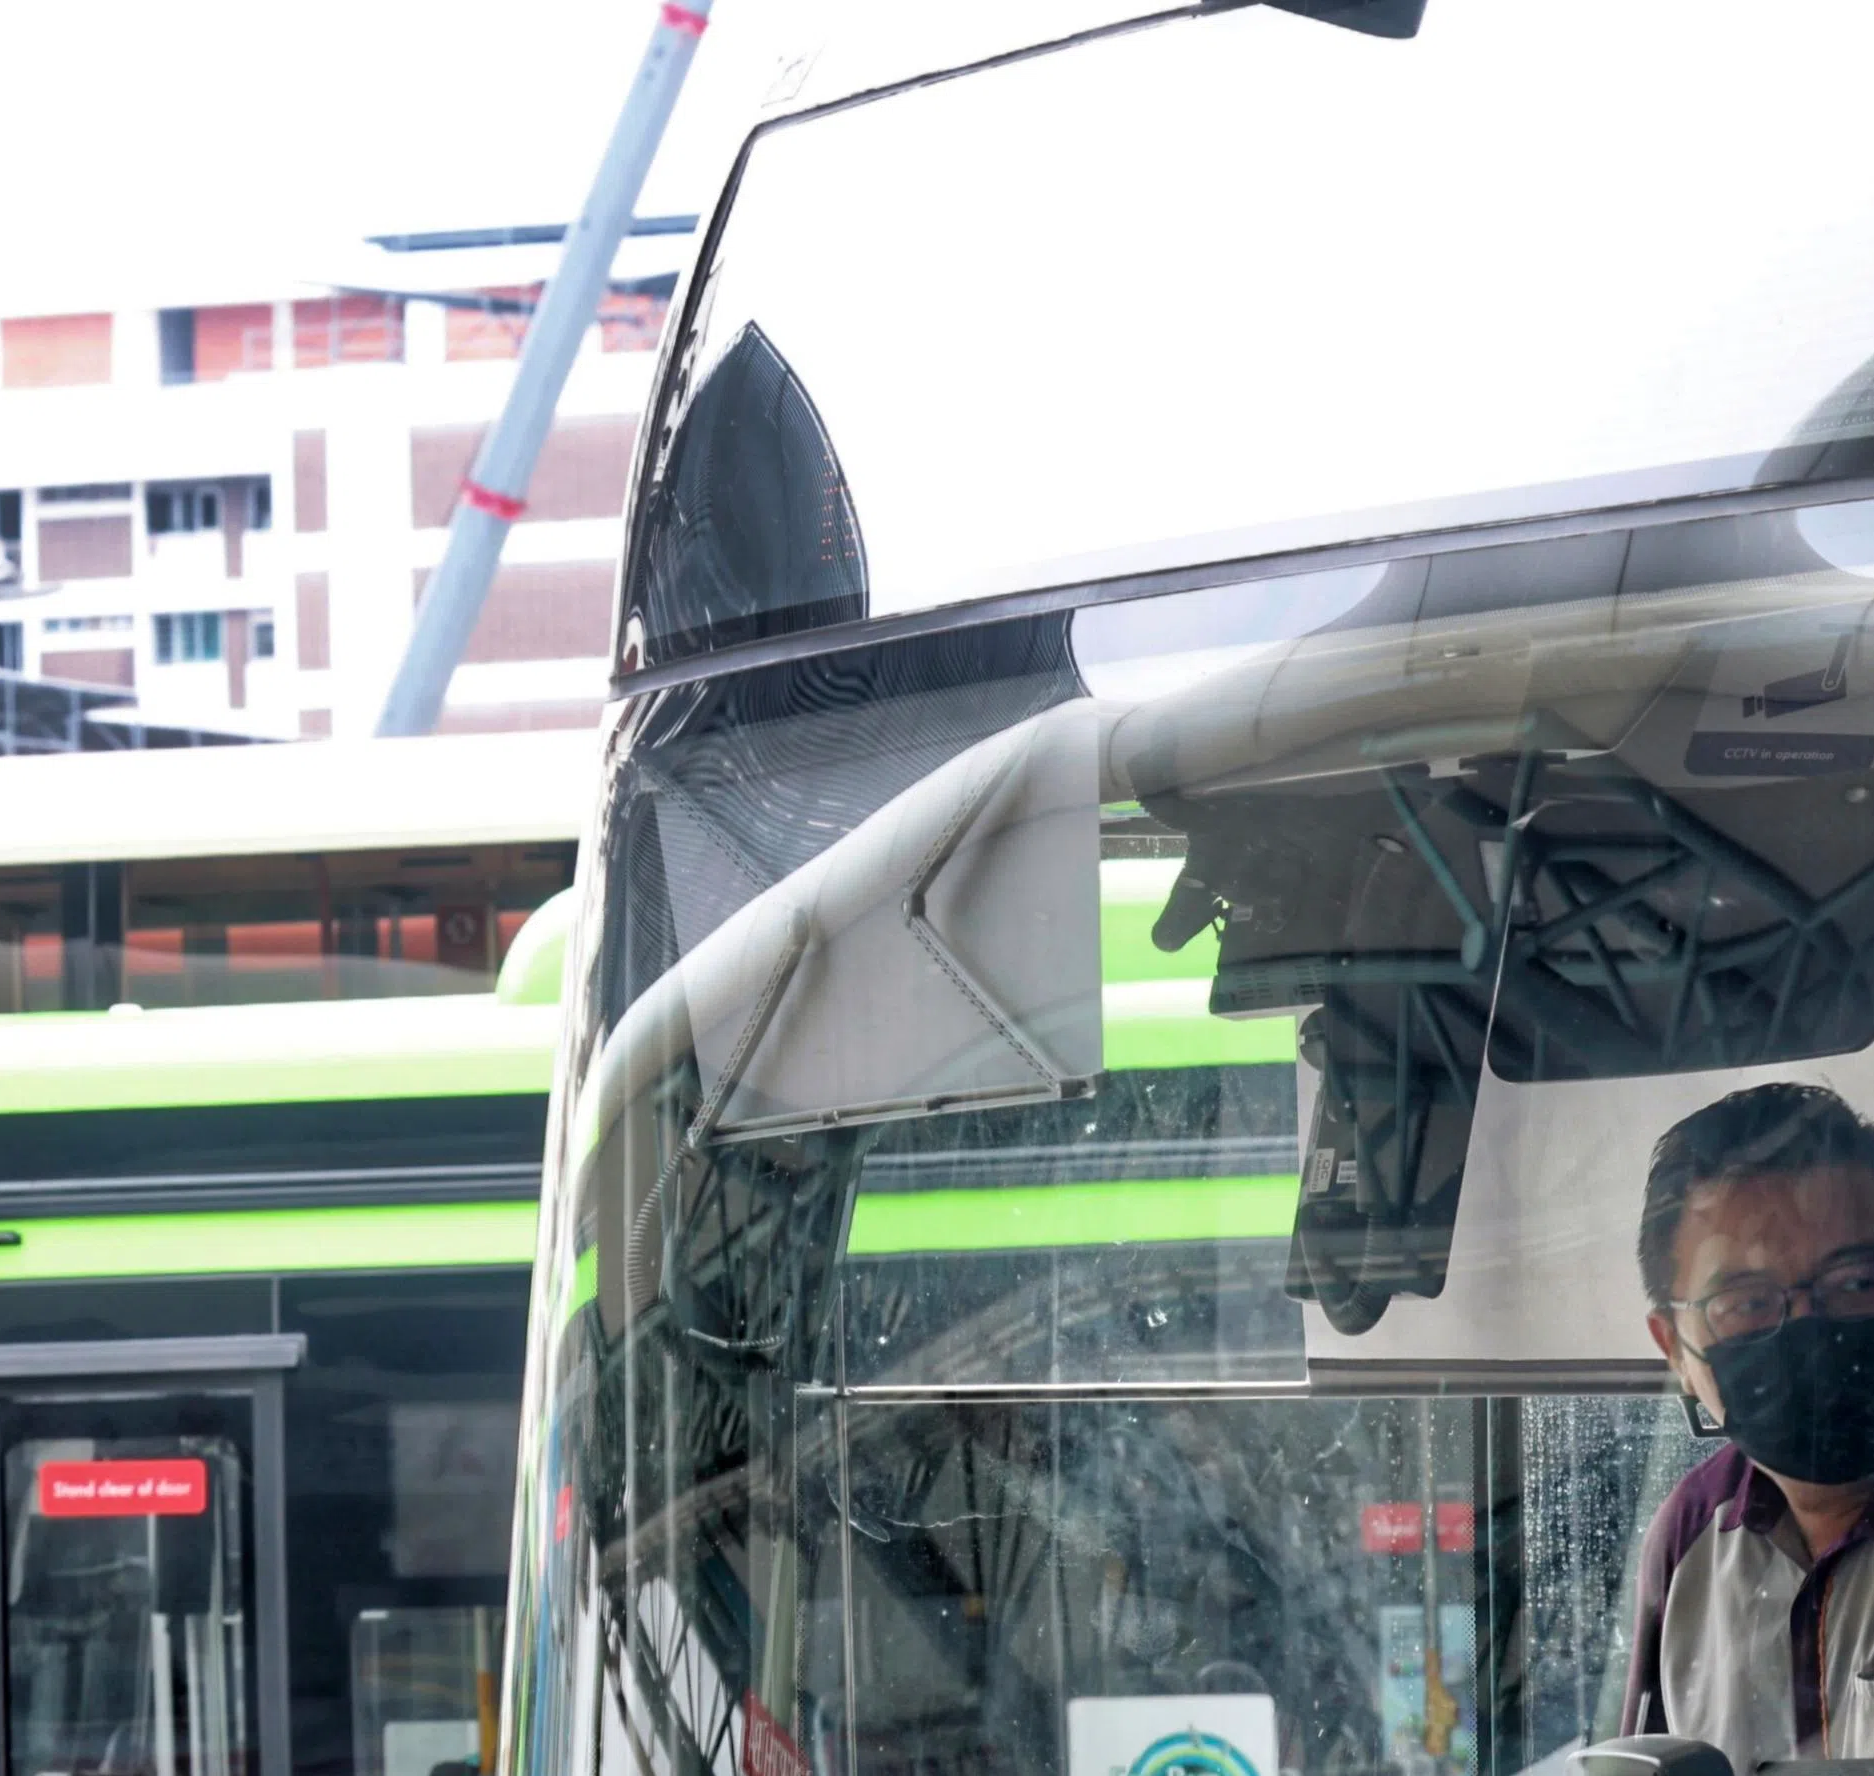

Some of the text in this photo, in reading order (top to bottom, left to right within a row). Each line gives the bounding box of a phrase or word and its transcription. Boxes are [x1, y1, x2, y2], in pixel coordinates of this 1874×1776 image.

[1724, 747, 1835, 762] CCTV in operation
[53, 1479, 96, 1499] Stand
[97, 1479, 134, 1498] clear
